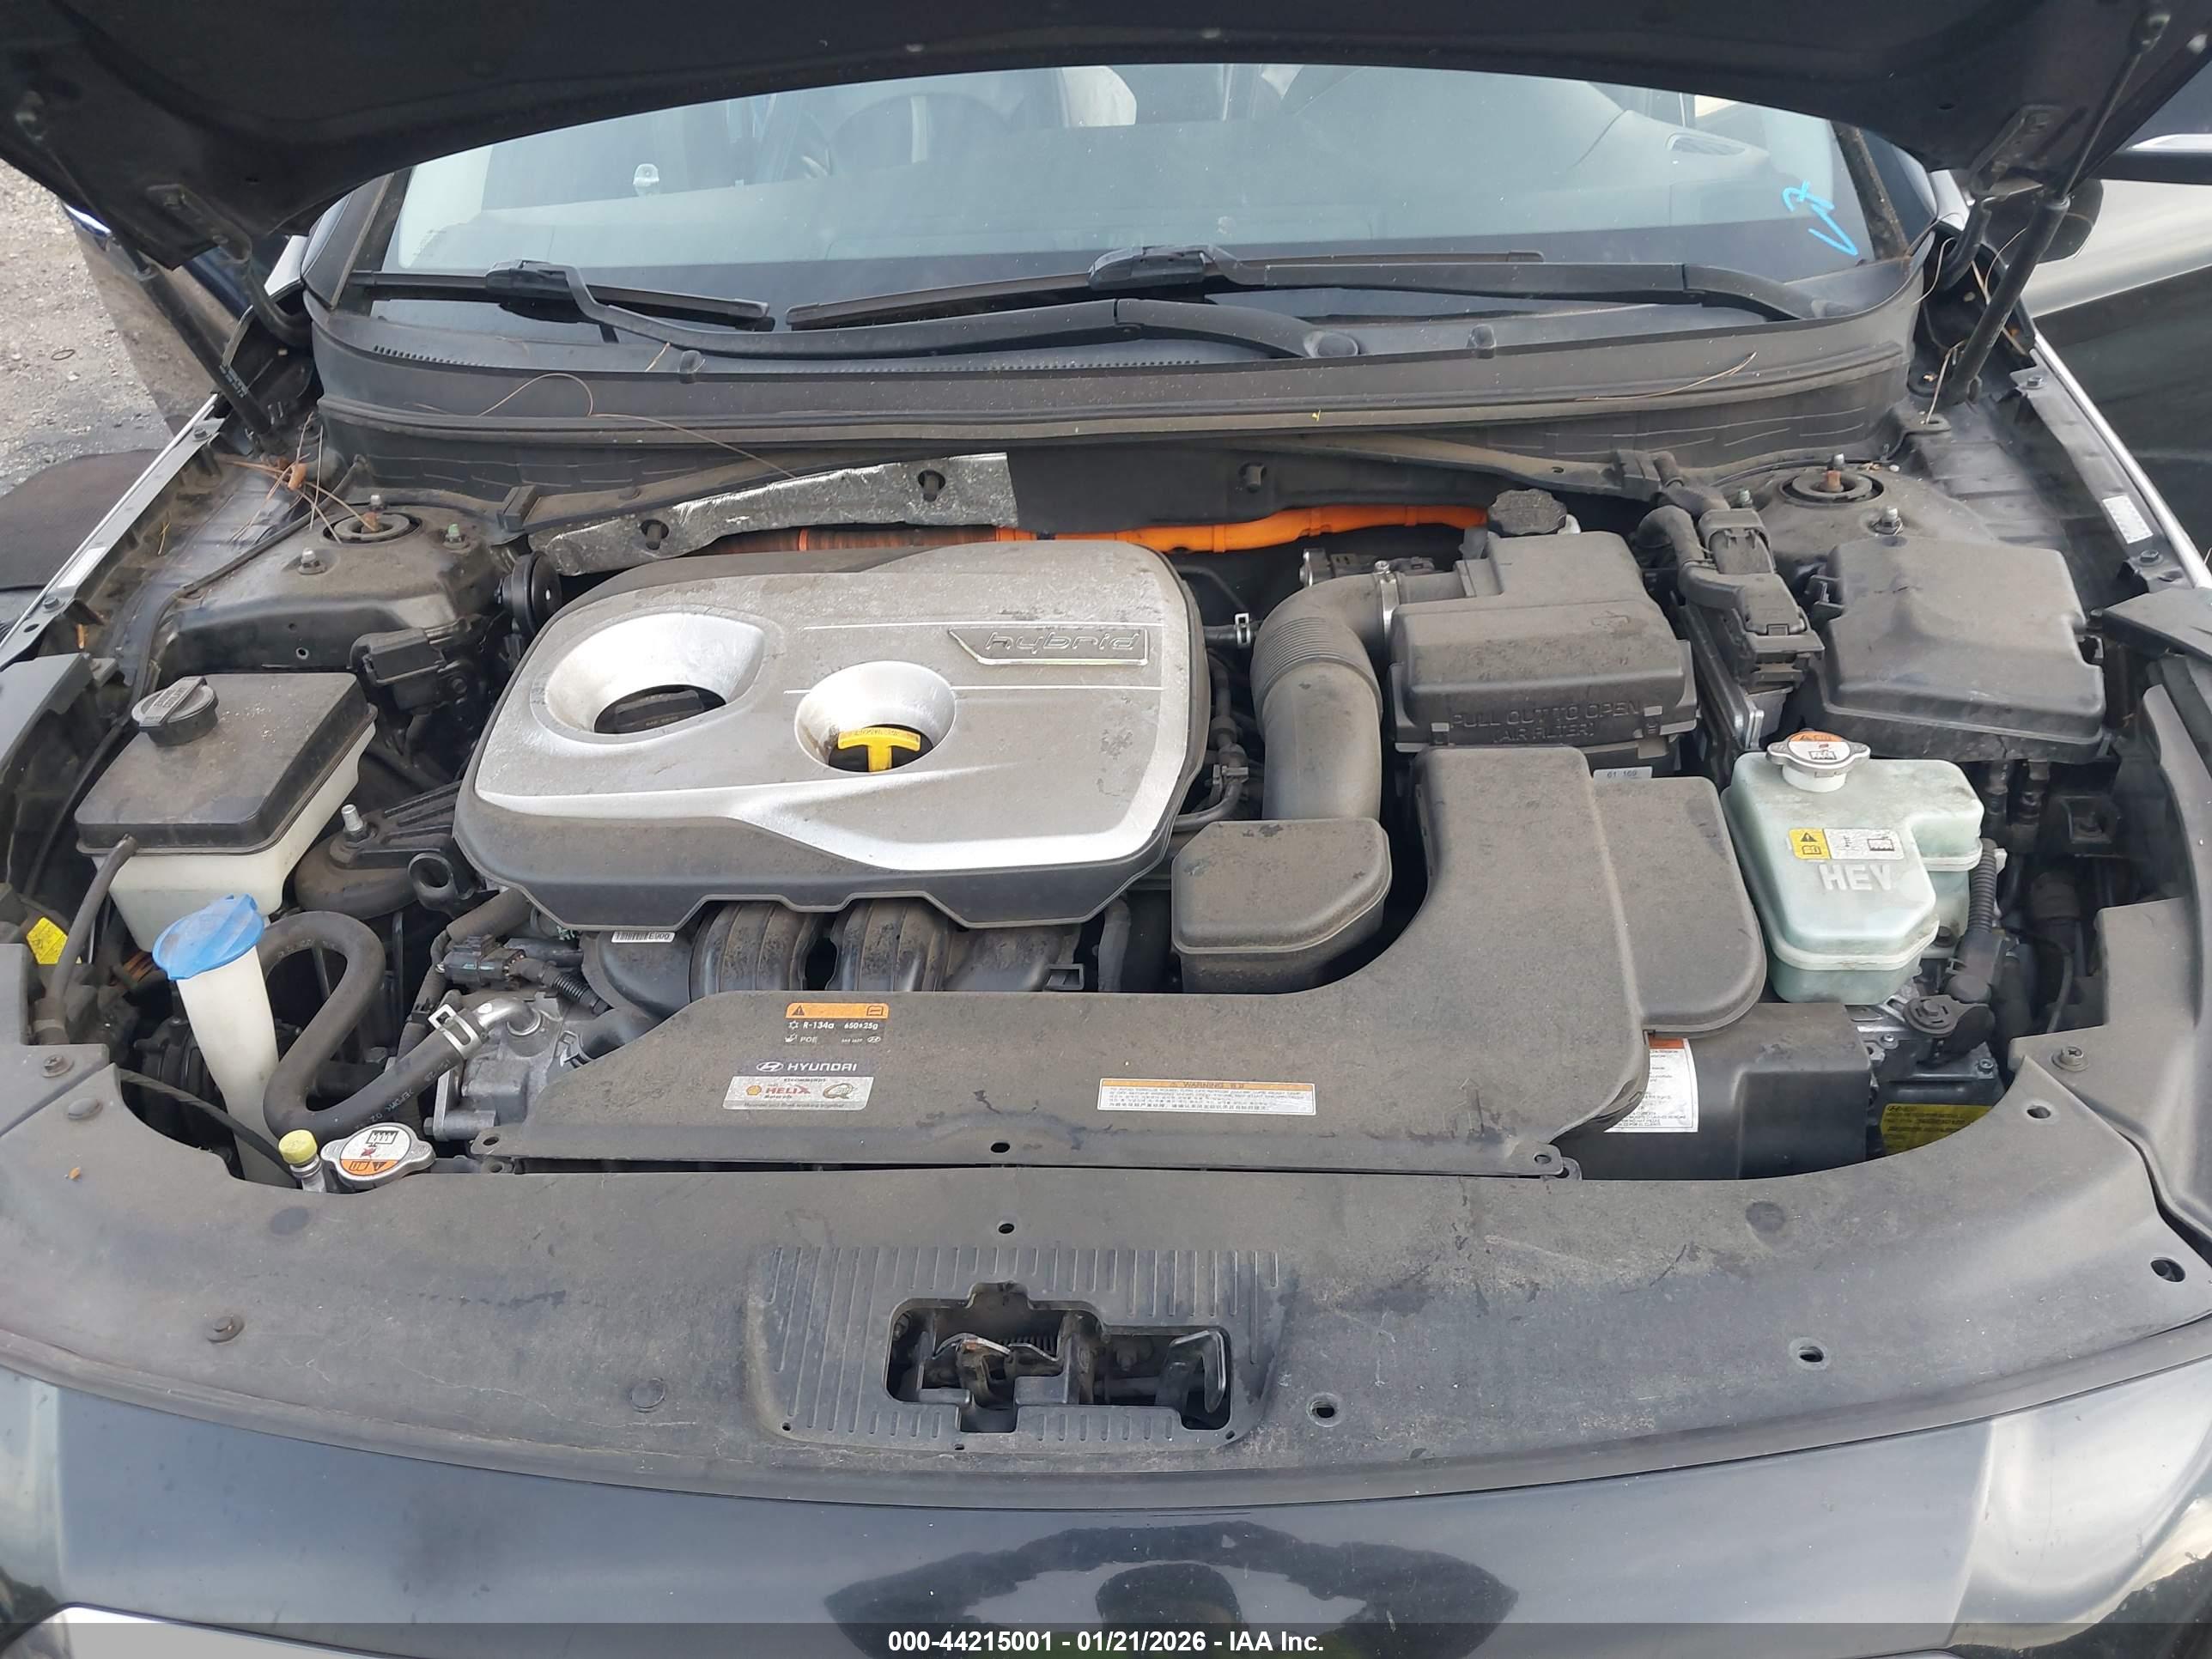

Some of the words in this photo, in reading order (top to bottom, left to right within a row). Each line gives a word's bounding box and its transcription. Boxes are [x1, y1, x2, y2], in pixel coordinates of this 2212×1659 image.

[986, 631, 1139, 654] hybrid
[1451, 714, 1501, 728] PULL
[1506, 708, 1542, 726] OUT
[1547, 706, 1578, 720] TO
[1586, 701, 1641, 719] OPEN
[1819, 864, 1893, 890] HEV
[803, 1021, 835, 1030] R-134a
[787, 1063, 858, 1072] HYUNDAI
[765, 1084, 811, 1095] HELIX
[1182, 1081, 1223, 1090] WARNING
